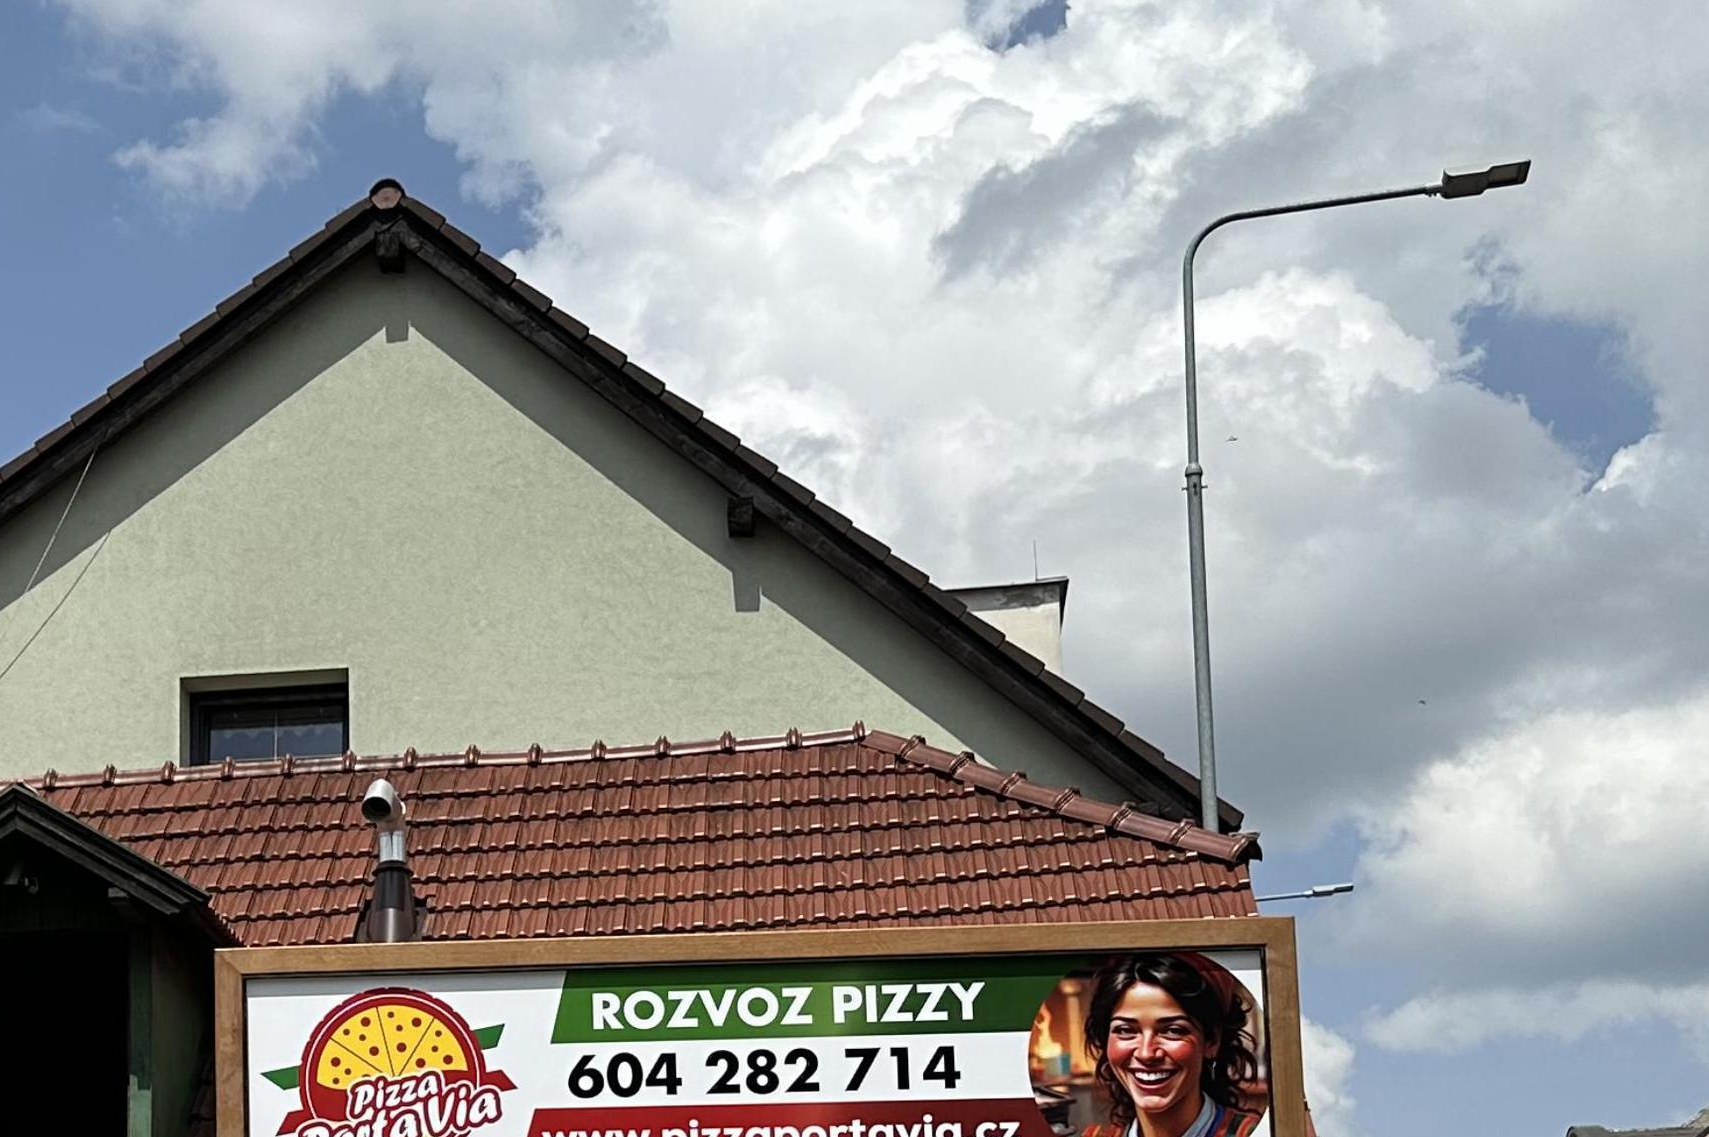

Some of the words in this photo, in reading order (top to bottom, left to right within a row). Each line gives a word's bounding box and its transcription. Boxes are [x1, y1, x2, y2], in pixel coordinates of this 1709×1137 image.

[591, 987, 814, 1030] ROZVOZ
[832, 981, 986, 1024] PIZZY
[353, 1073, 440, 1117] Pizza
[567, 1052, 683, 1099] 604
[704, 1047, 820, 1095] 282
[844, 1045, 961, 1092] 714
